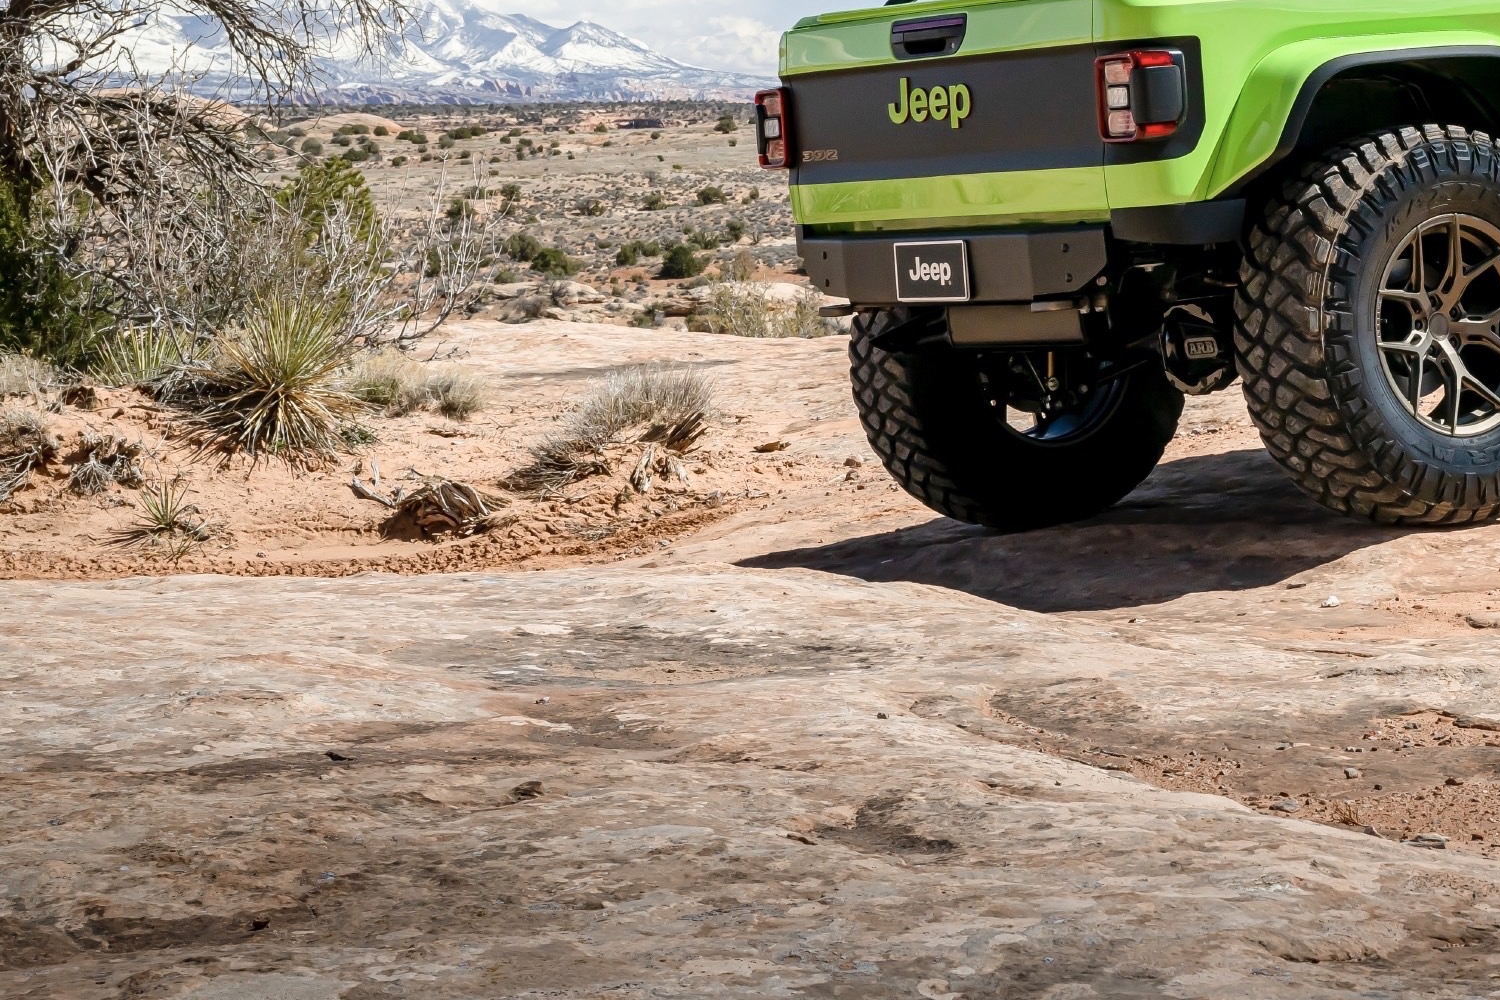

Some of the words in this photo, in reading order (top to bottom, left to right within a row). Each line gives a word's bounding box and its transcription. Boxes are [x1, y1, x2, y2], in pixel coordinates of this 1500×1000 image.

[887, 77, 971, 129] Jeep
[802, 149, 838, 162] 392
[908, 256, 951, 286] Jeep
